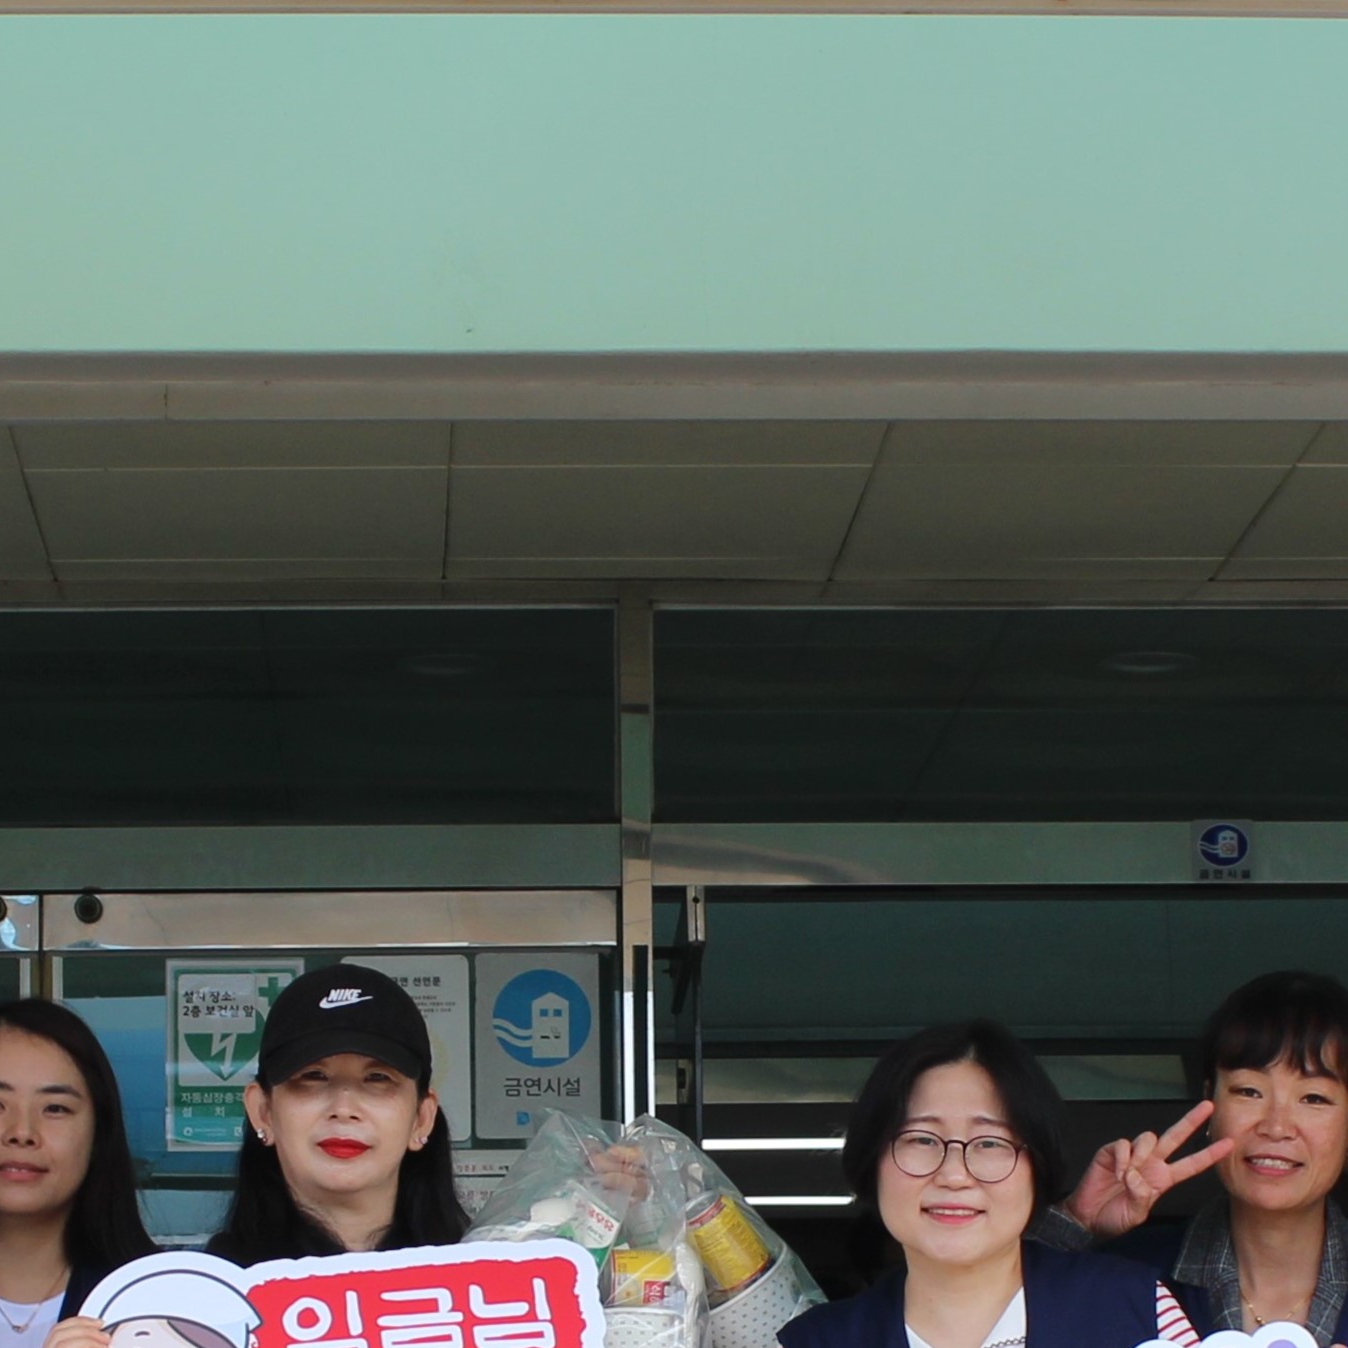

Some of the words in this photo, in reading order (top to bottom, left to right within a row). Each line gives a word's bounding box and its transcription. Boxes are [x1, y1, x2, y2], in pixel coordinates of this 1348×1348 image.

[328, 988, 362, 1002] NIKE
[183, 1005, 201, 1018] 2층
[503, 1077, 581, 1097] 금연시설
